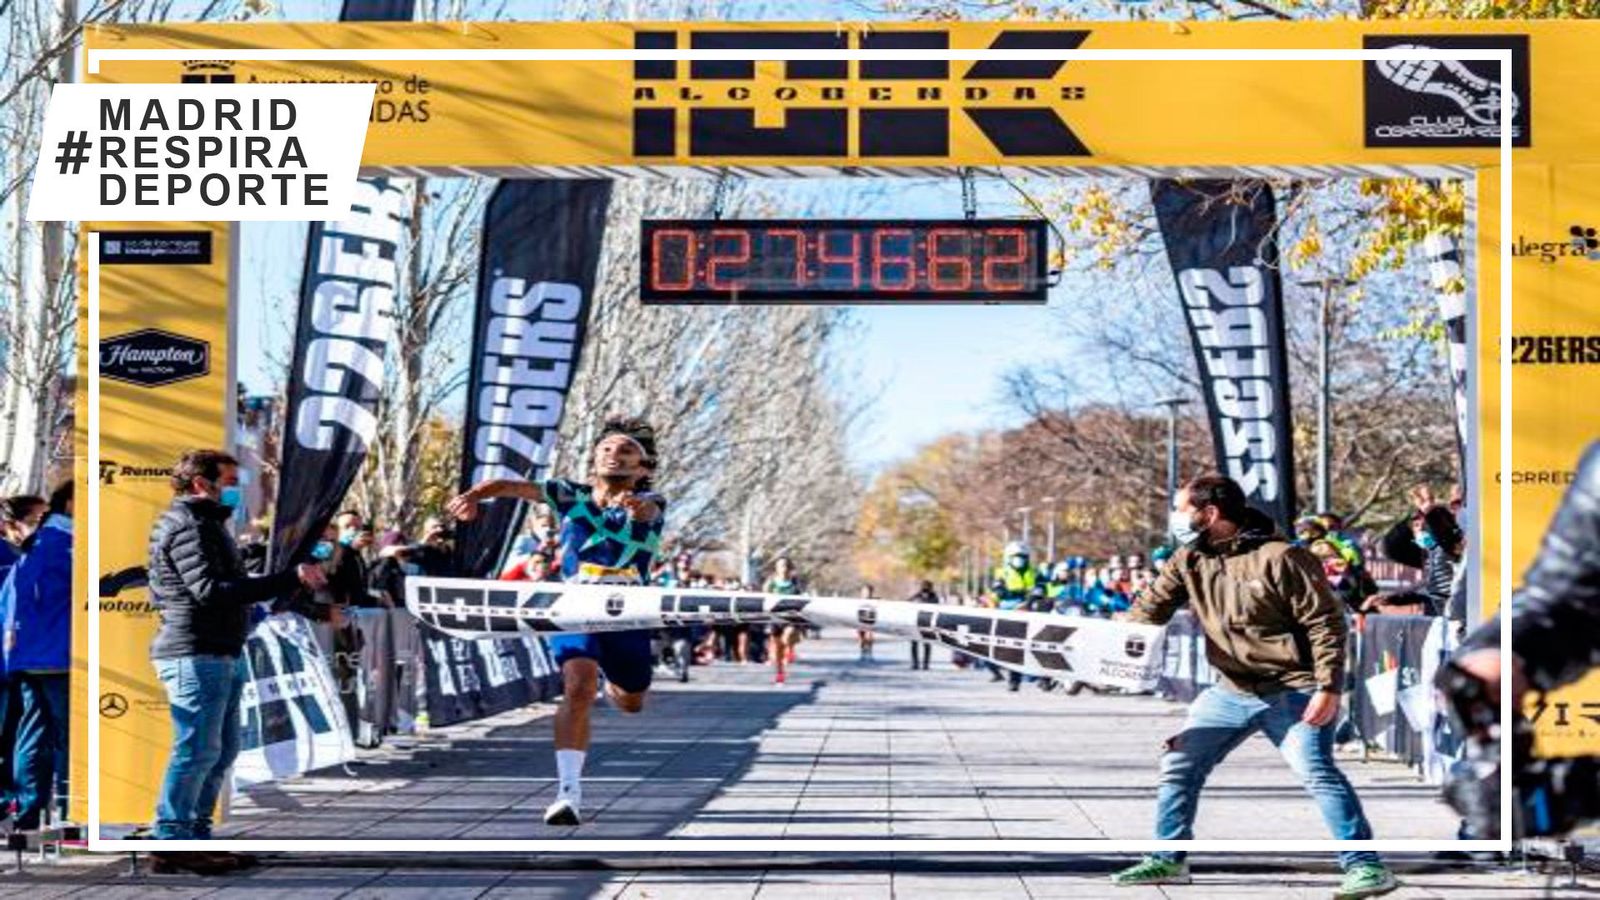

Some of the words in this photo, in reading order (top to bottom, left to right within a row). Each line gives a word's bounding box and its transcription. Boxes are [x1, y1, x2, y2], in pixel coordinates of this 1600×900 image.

[404, 75, 429, 94] de
[633, 87, 1087, 101] ALCOBENDAS
[99, 343, 204, 366] Hampton
